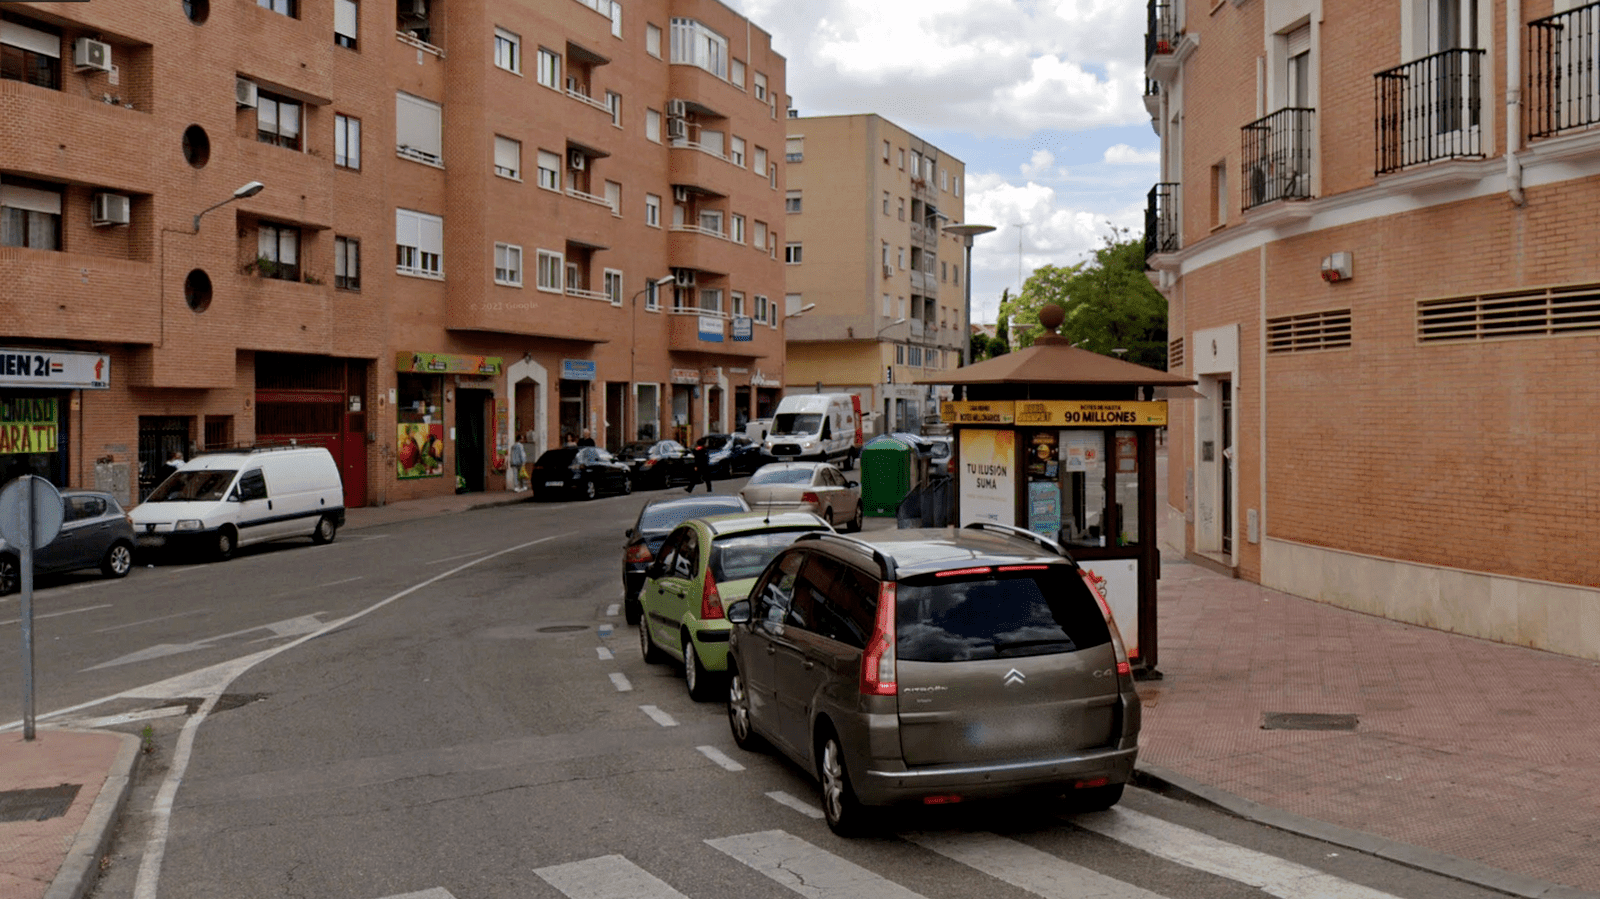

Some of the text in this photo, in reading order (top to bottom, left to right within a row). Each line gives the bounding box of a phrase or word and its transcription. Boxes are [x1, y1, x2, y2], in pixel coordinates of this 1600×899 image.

[1065, 411, 1080, 422] 90
[1082, 411, 1137, 422] MILLONES
[967, 463, 977, 474] TU
[976, 478, 997, 489] SUMA
[1092, 668, 1113, 679] C4
